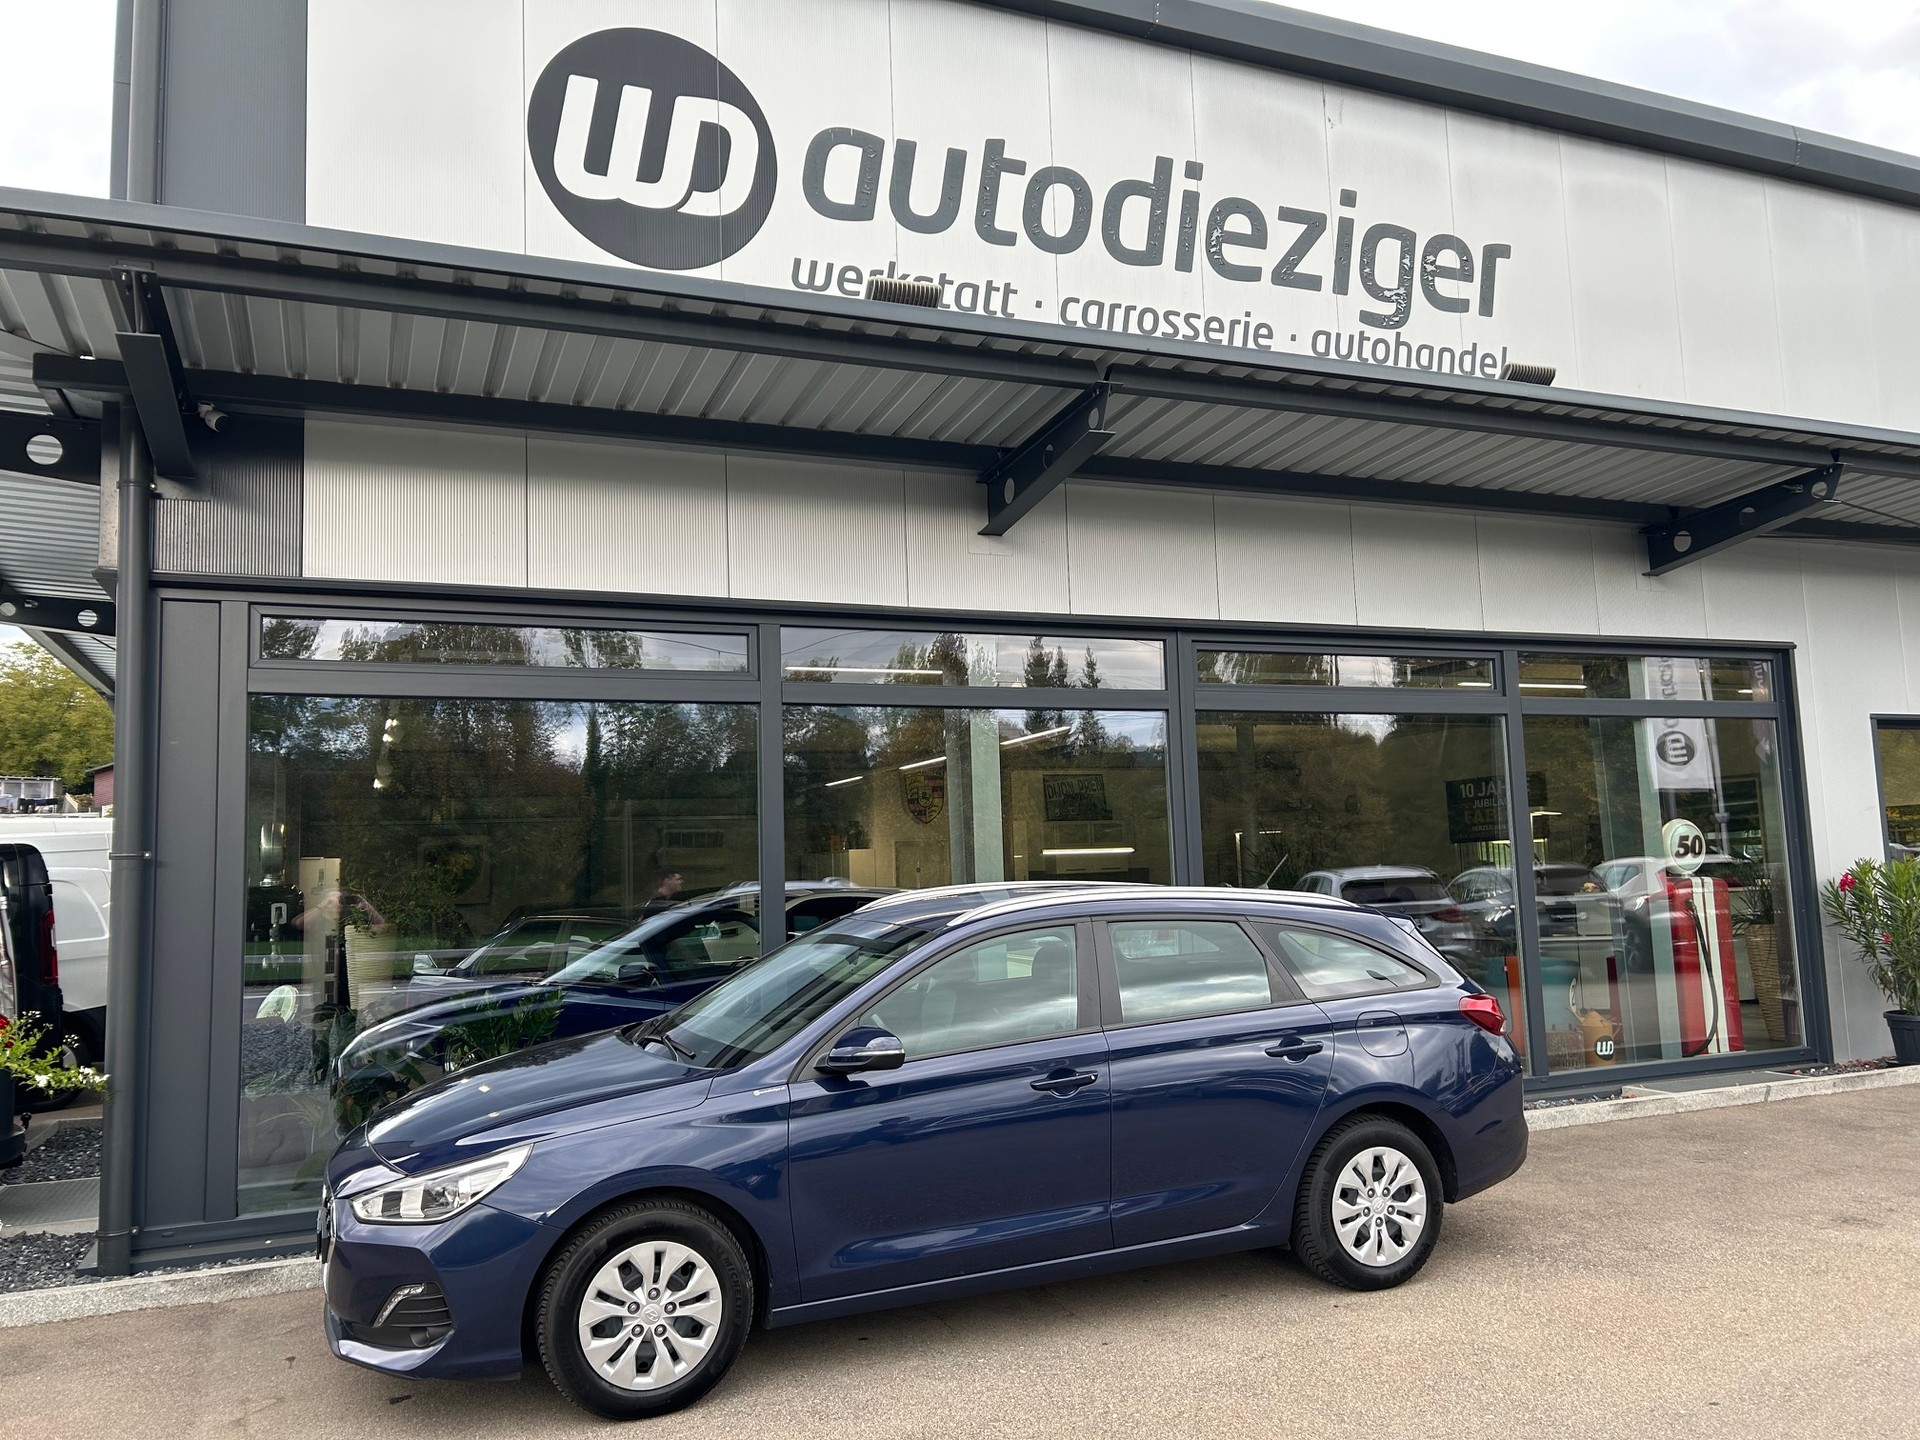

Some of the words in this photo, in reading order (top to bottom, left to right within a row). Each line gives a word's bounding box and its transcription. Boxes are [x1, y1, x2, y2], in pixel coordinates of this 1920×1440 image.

[802, 126, 1511, 329] autodieziger
[1060, 296, 1273, 349] carrosserie
[1312, 328, 1507, 379] autohandel
[1459, 783, 1474, 798] 10
[1674, 834, 1702, 858] 50
[723, 1256, 742, 1318] MICHELIN
